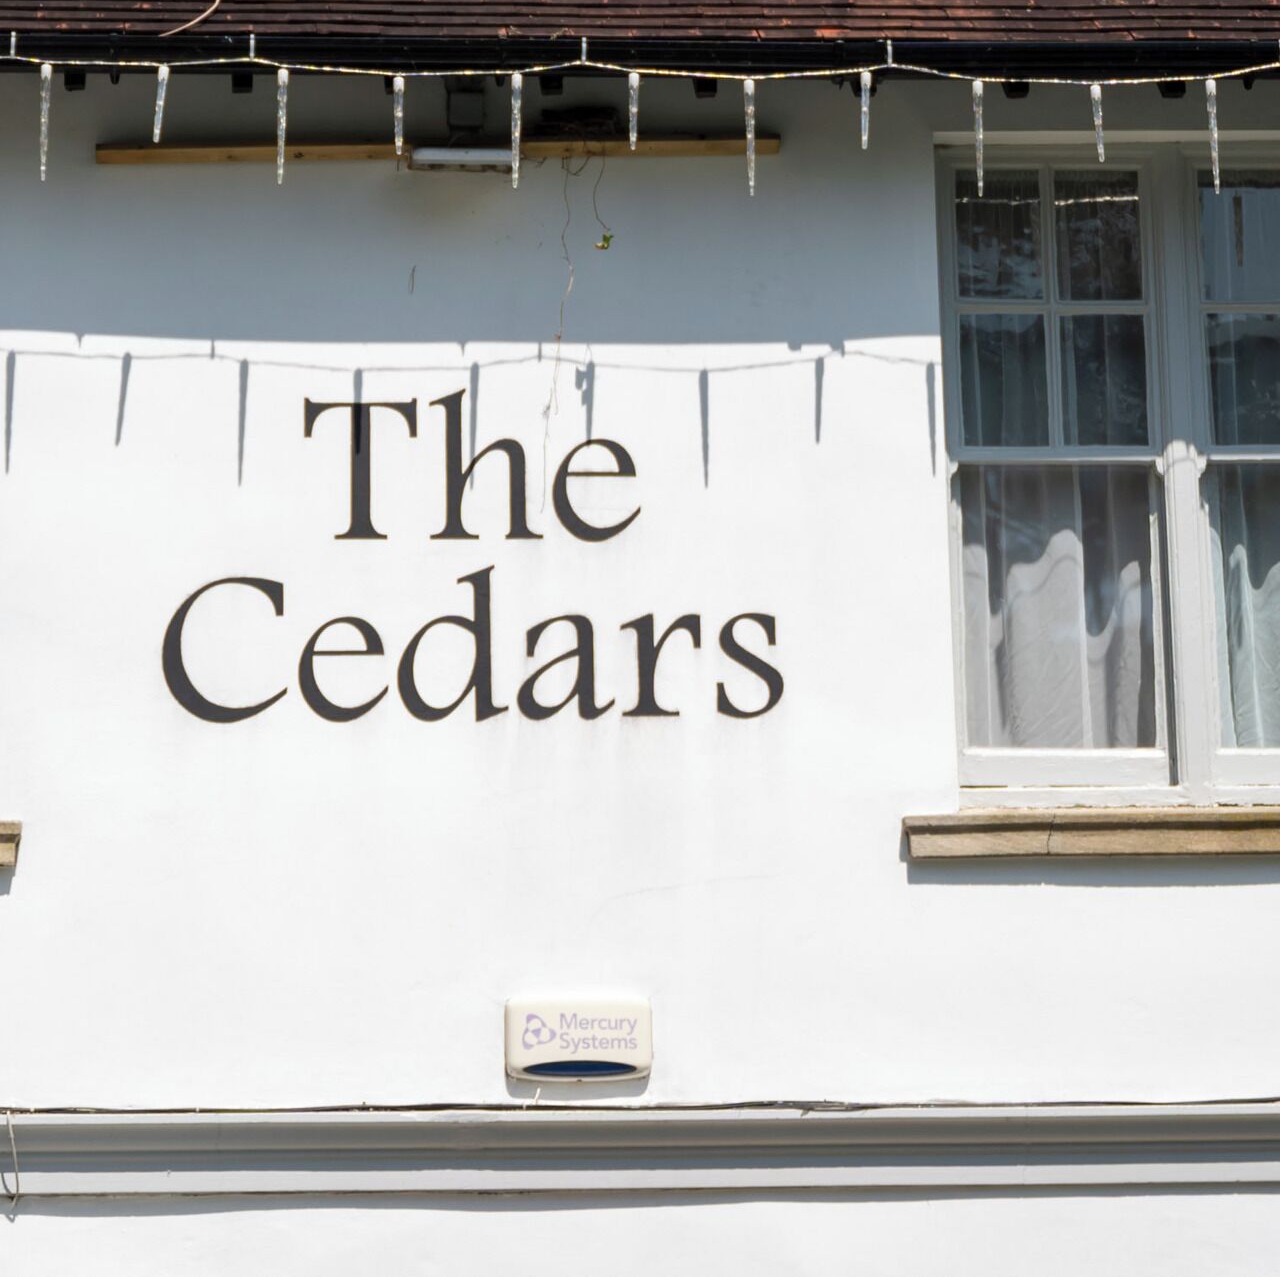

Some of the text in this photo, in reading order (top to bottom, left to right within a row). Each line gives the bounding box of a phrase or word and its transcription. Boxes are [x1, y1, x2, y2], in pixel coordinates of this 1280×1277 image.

[304, 389, 642, 542] The
[162, 565, 785, 723] Cedars
[560, 1012, 638, 1035] Mercury
[560, 1032, 638, 1054] Systems
